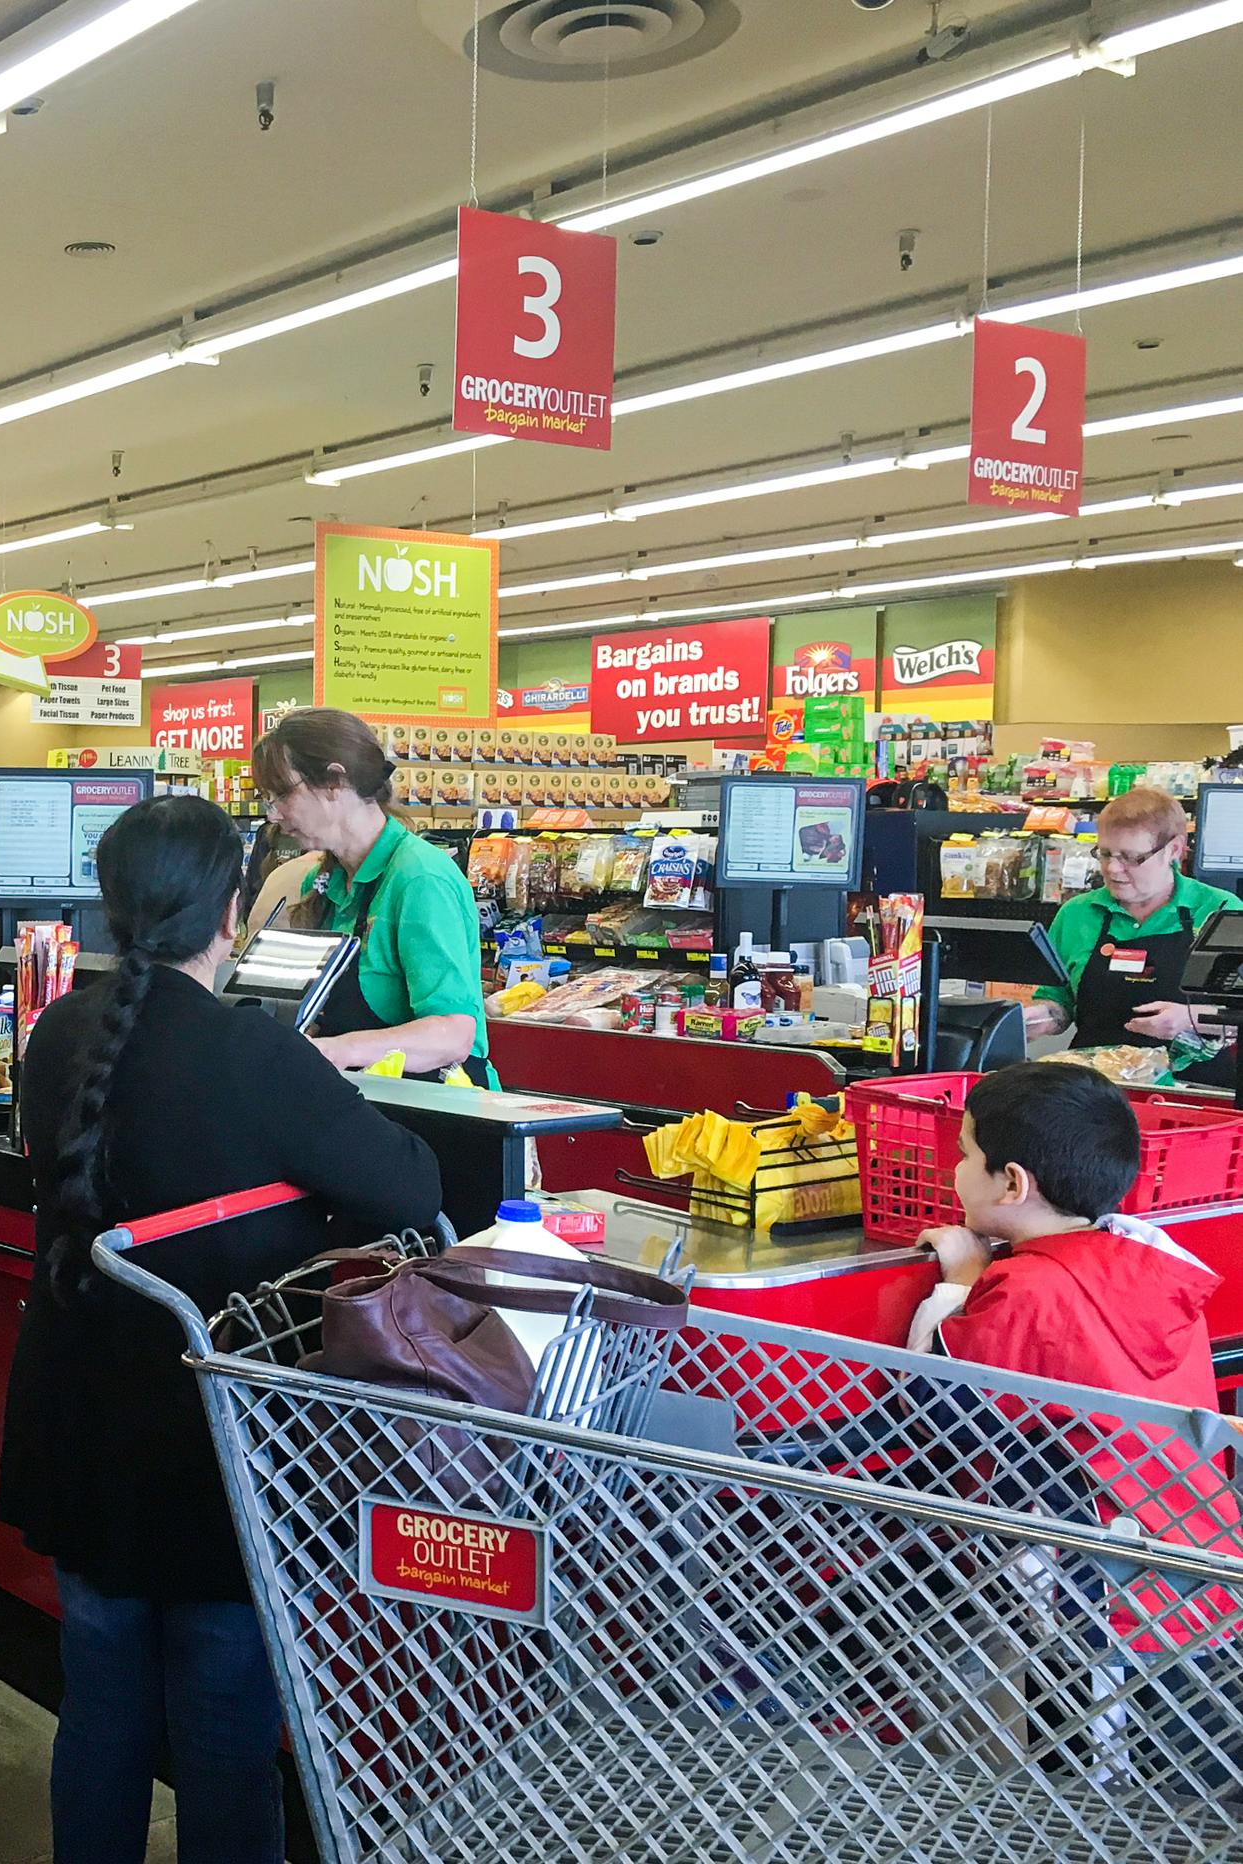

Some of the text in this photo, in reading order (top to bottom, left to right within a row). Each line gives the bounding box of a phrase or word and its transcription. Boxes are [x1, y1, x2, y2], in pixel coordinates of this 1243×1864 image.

[513, 255, 562, 359] 3
[1011, 356, 1047, 445] 2
[484, 402, 587, 435] bargain market
[989, 479, 1063, 505] bargain market
[358, 548, 457, 599] NOSH
[7, 606, 75, 635] NOSH
[103, 644, 121, 677] 3
[596, 638, 703, 671] Bargains
[897, 644, 974, 679] Welch's
[58, 682, 78, 692] Tissue
[101, 684, 111, 693] Pet
[112, 685, 126, 693] Food
[524, 690, 586, 703] GHIRARDELLI
[616, 666, 740, 699] on brands
[785, 665, 859, 697] Folgers
[39, 709, 135, 721] Facial Tissue Paper Products
[59, 696, 80, 705] Towels
[97, 697, 113, 708] Large
[114, 698, 129, 707] Sizes
[163, 698, 236, 725] shop us first.
[636, 696, 760, 735] you trust!
[155, 724, 244, 751] GET MORE
[775, 720, 792, 736] Tide
[169, 752, 189, 768] TREE
[396, 1513, 510, 1553] GROCERY
[413, 1540, 494, 1576] OUTLET
[396, 1557, 510, 1596] bargain market
